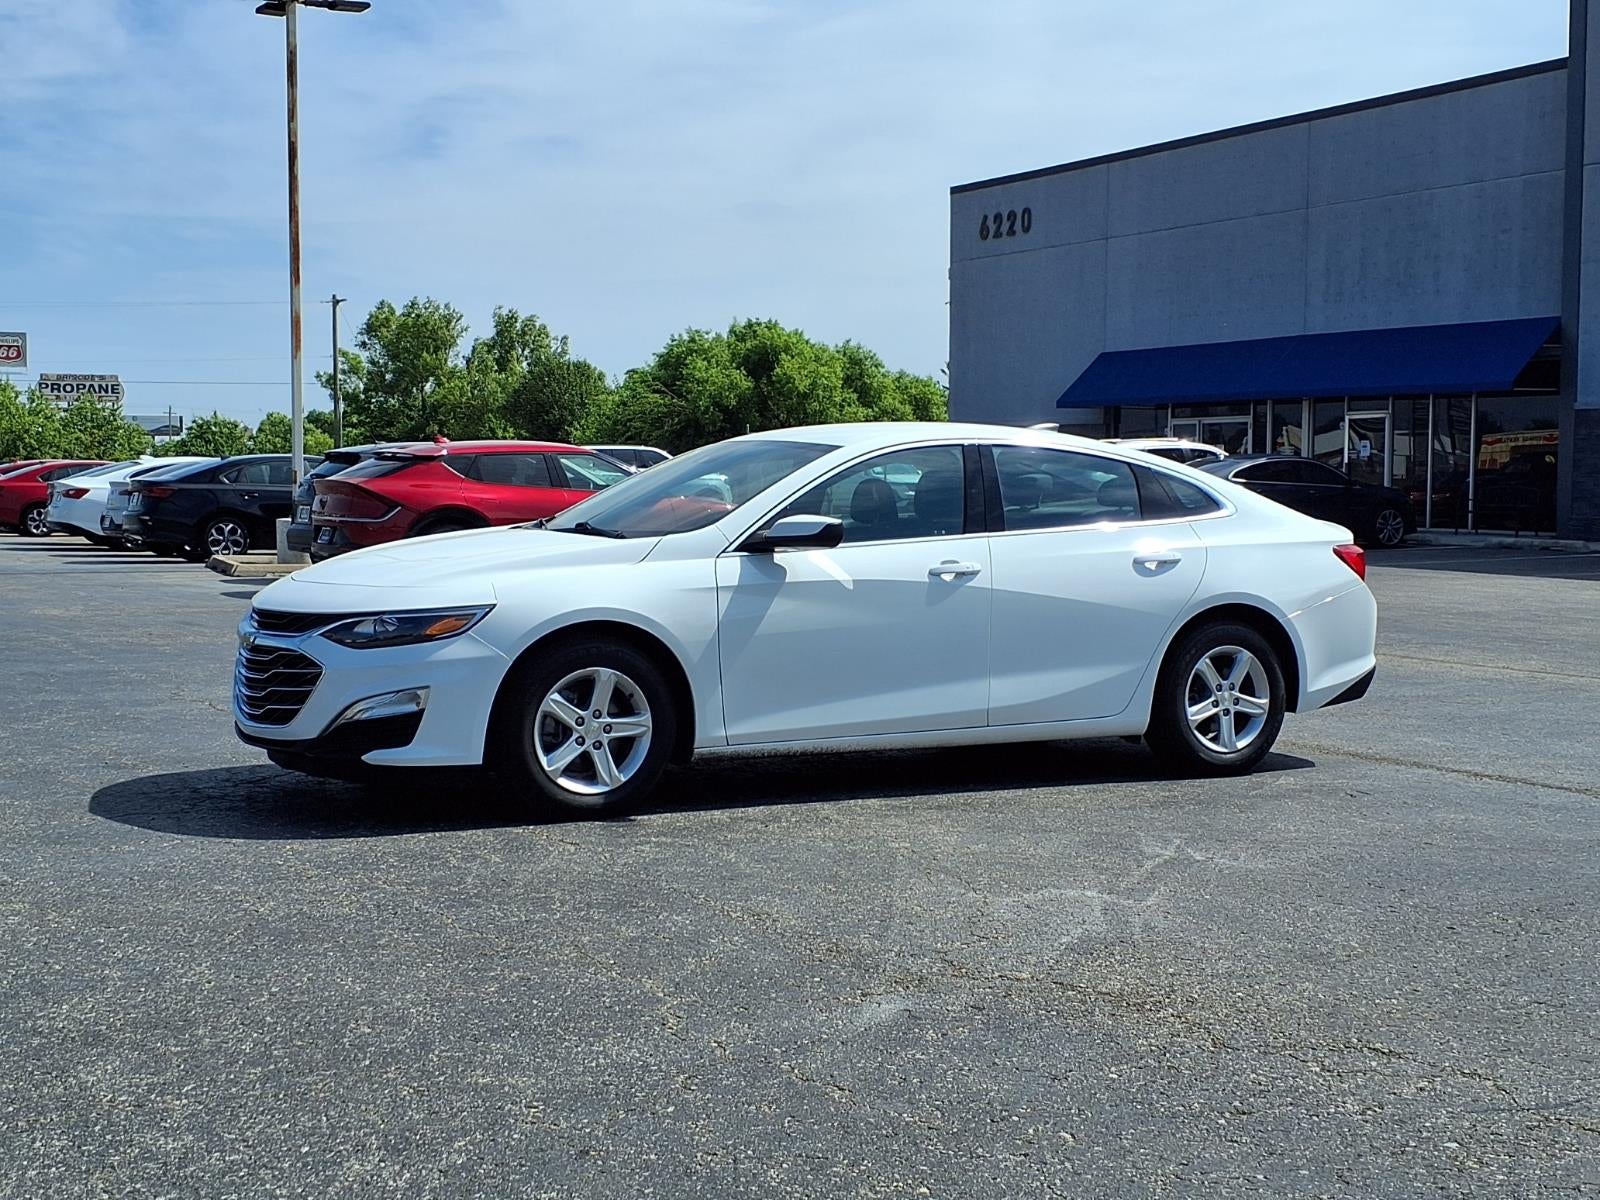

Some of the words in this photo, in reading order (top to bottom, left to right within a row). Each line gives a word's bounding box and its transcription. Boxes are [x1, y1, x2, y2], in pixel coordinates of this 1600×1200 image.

[979, 207, 1032, 240] 6220
[0, 346, 18, 356] 66
[38, 382, 120, 395] PROPANE
